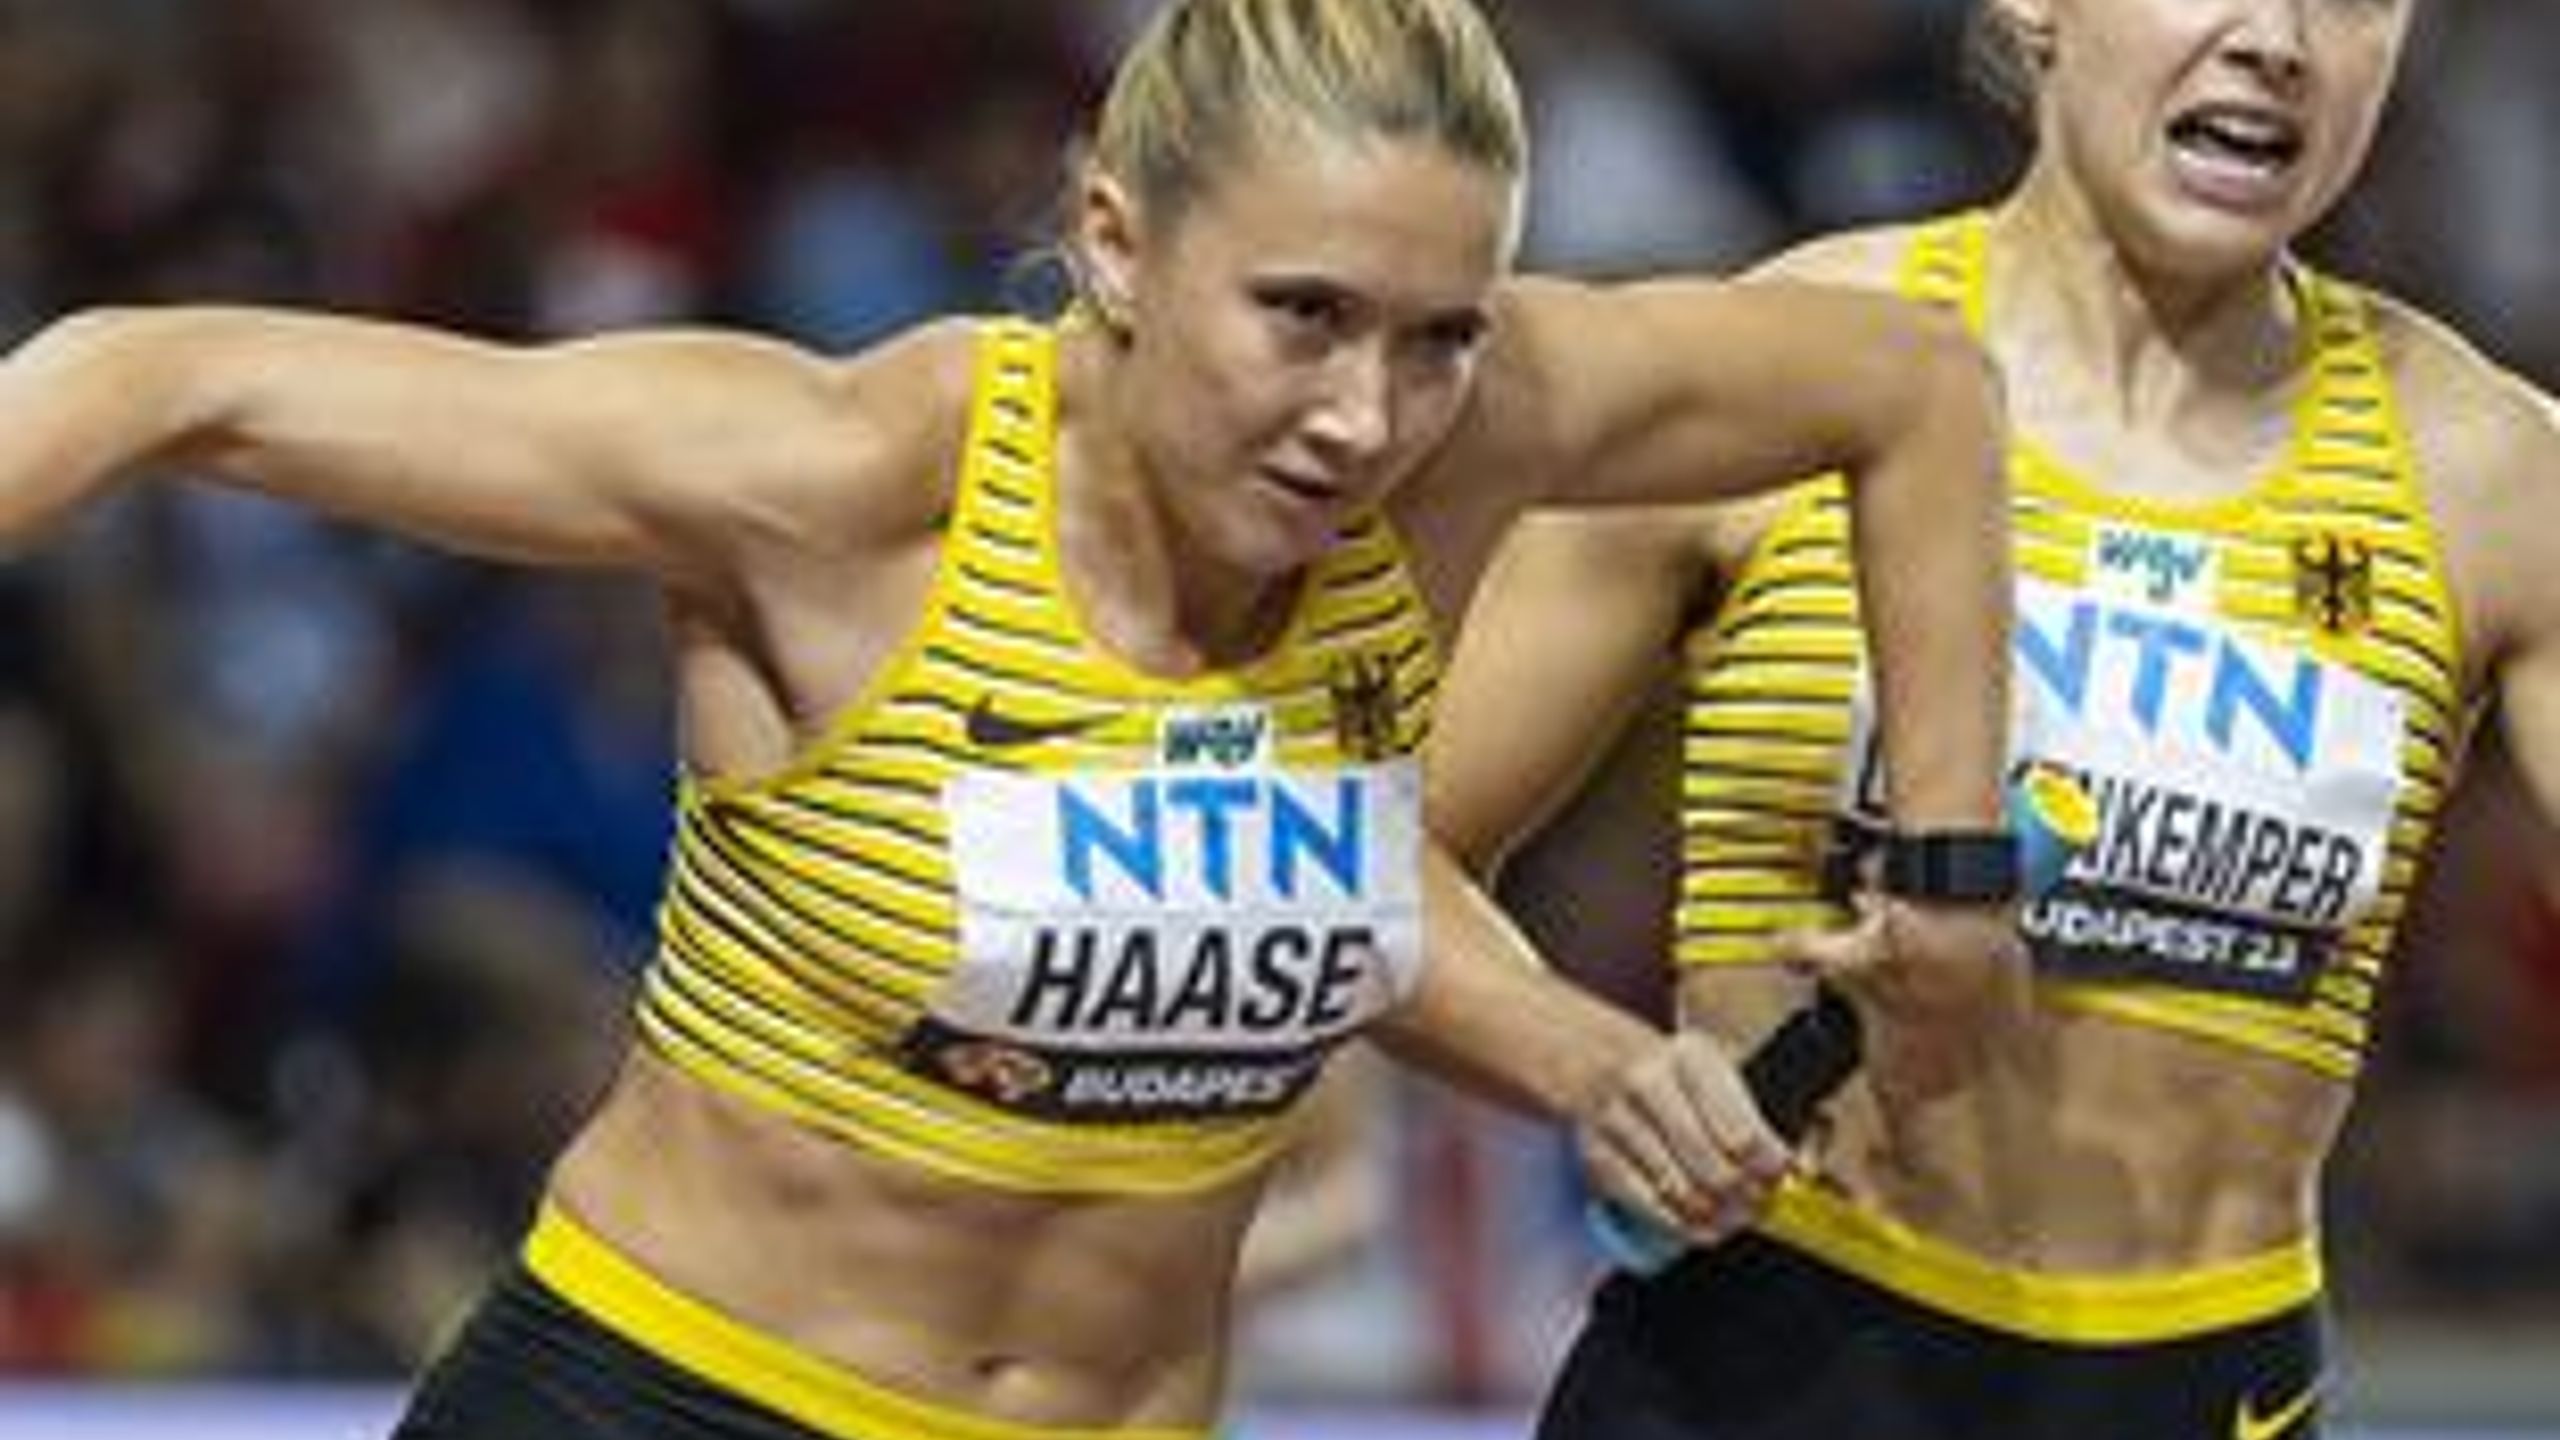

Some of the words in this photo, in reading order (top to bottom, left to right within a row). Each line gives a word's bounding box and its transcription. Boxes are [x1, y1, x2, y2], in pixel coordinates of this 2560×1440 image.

[2012, 602, 2322, 773] NTN
[1055, 776, 1363, 901] NTN
[1008, 925, 1374, 1030] HAASE
[2020, 898, 2240, 963] UDAPEST
[1064, 1064, 1290, 1106] BUDAPES
